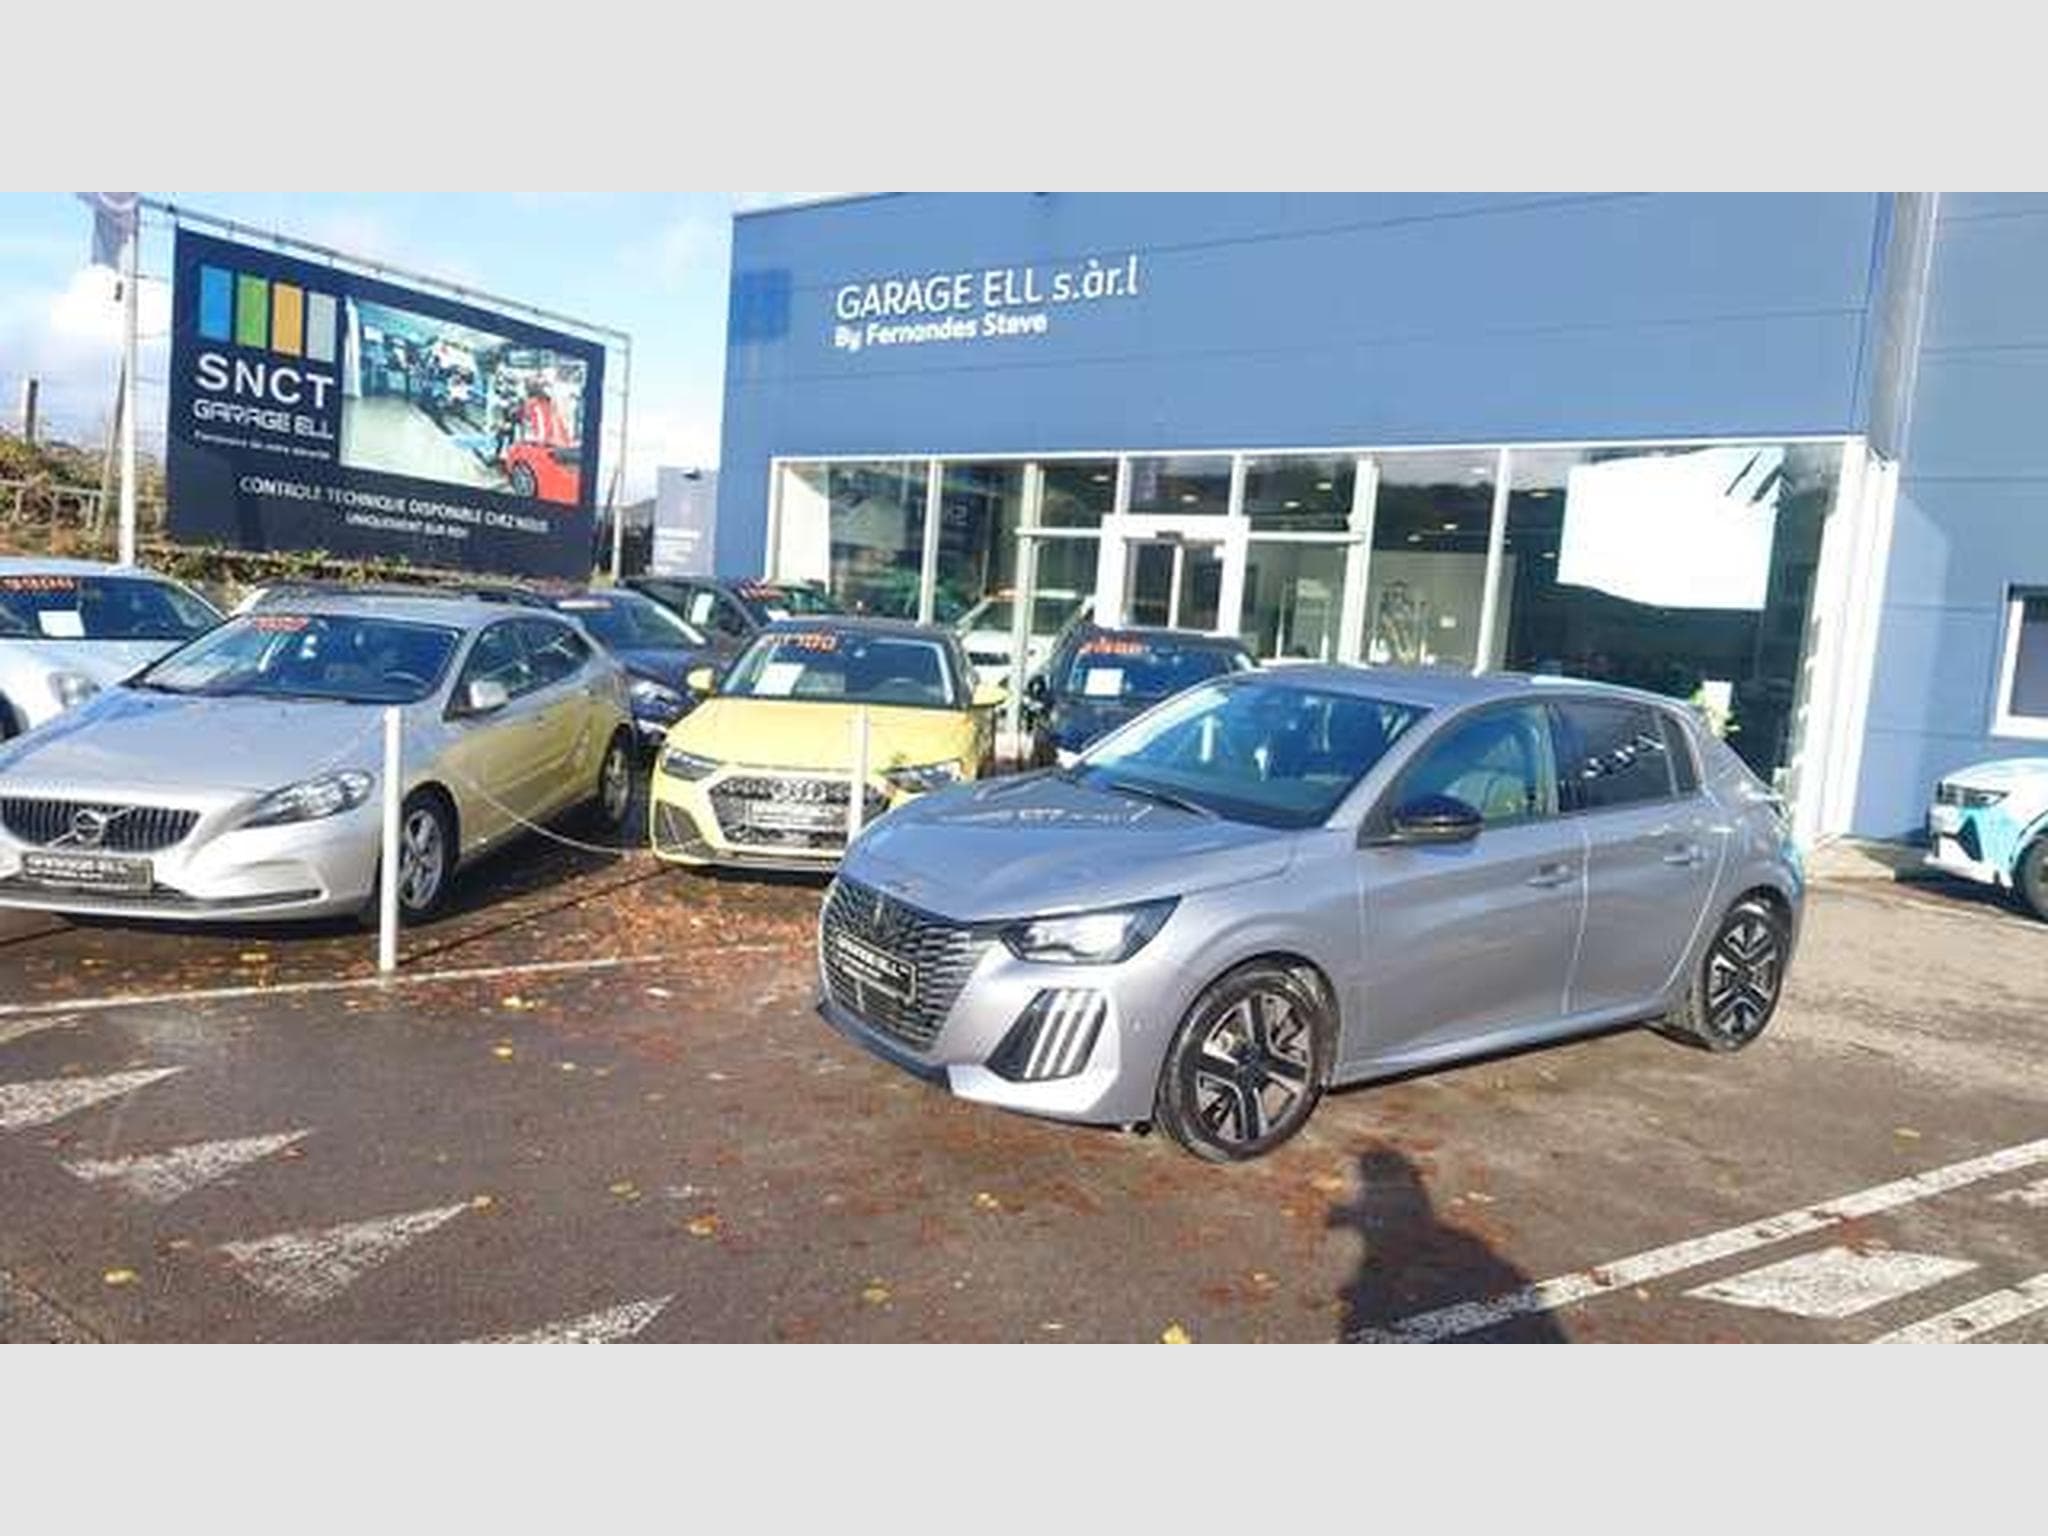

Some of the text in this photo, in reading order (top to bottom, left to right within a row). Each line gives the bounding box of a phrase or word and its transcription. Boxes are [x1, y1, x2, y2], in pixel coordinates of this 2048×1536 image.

[836, 272, 974, 320] GARAGE
[983, 267, 1043, 307] ELL
[834, 324, 862, 352] By
[866, 316, 977, 346] Fernandes
[196, 352, 335, 409] SNCT
[193, 398, 335, 440] GARAGE ELL
